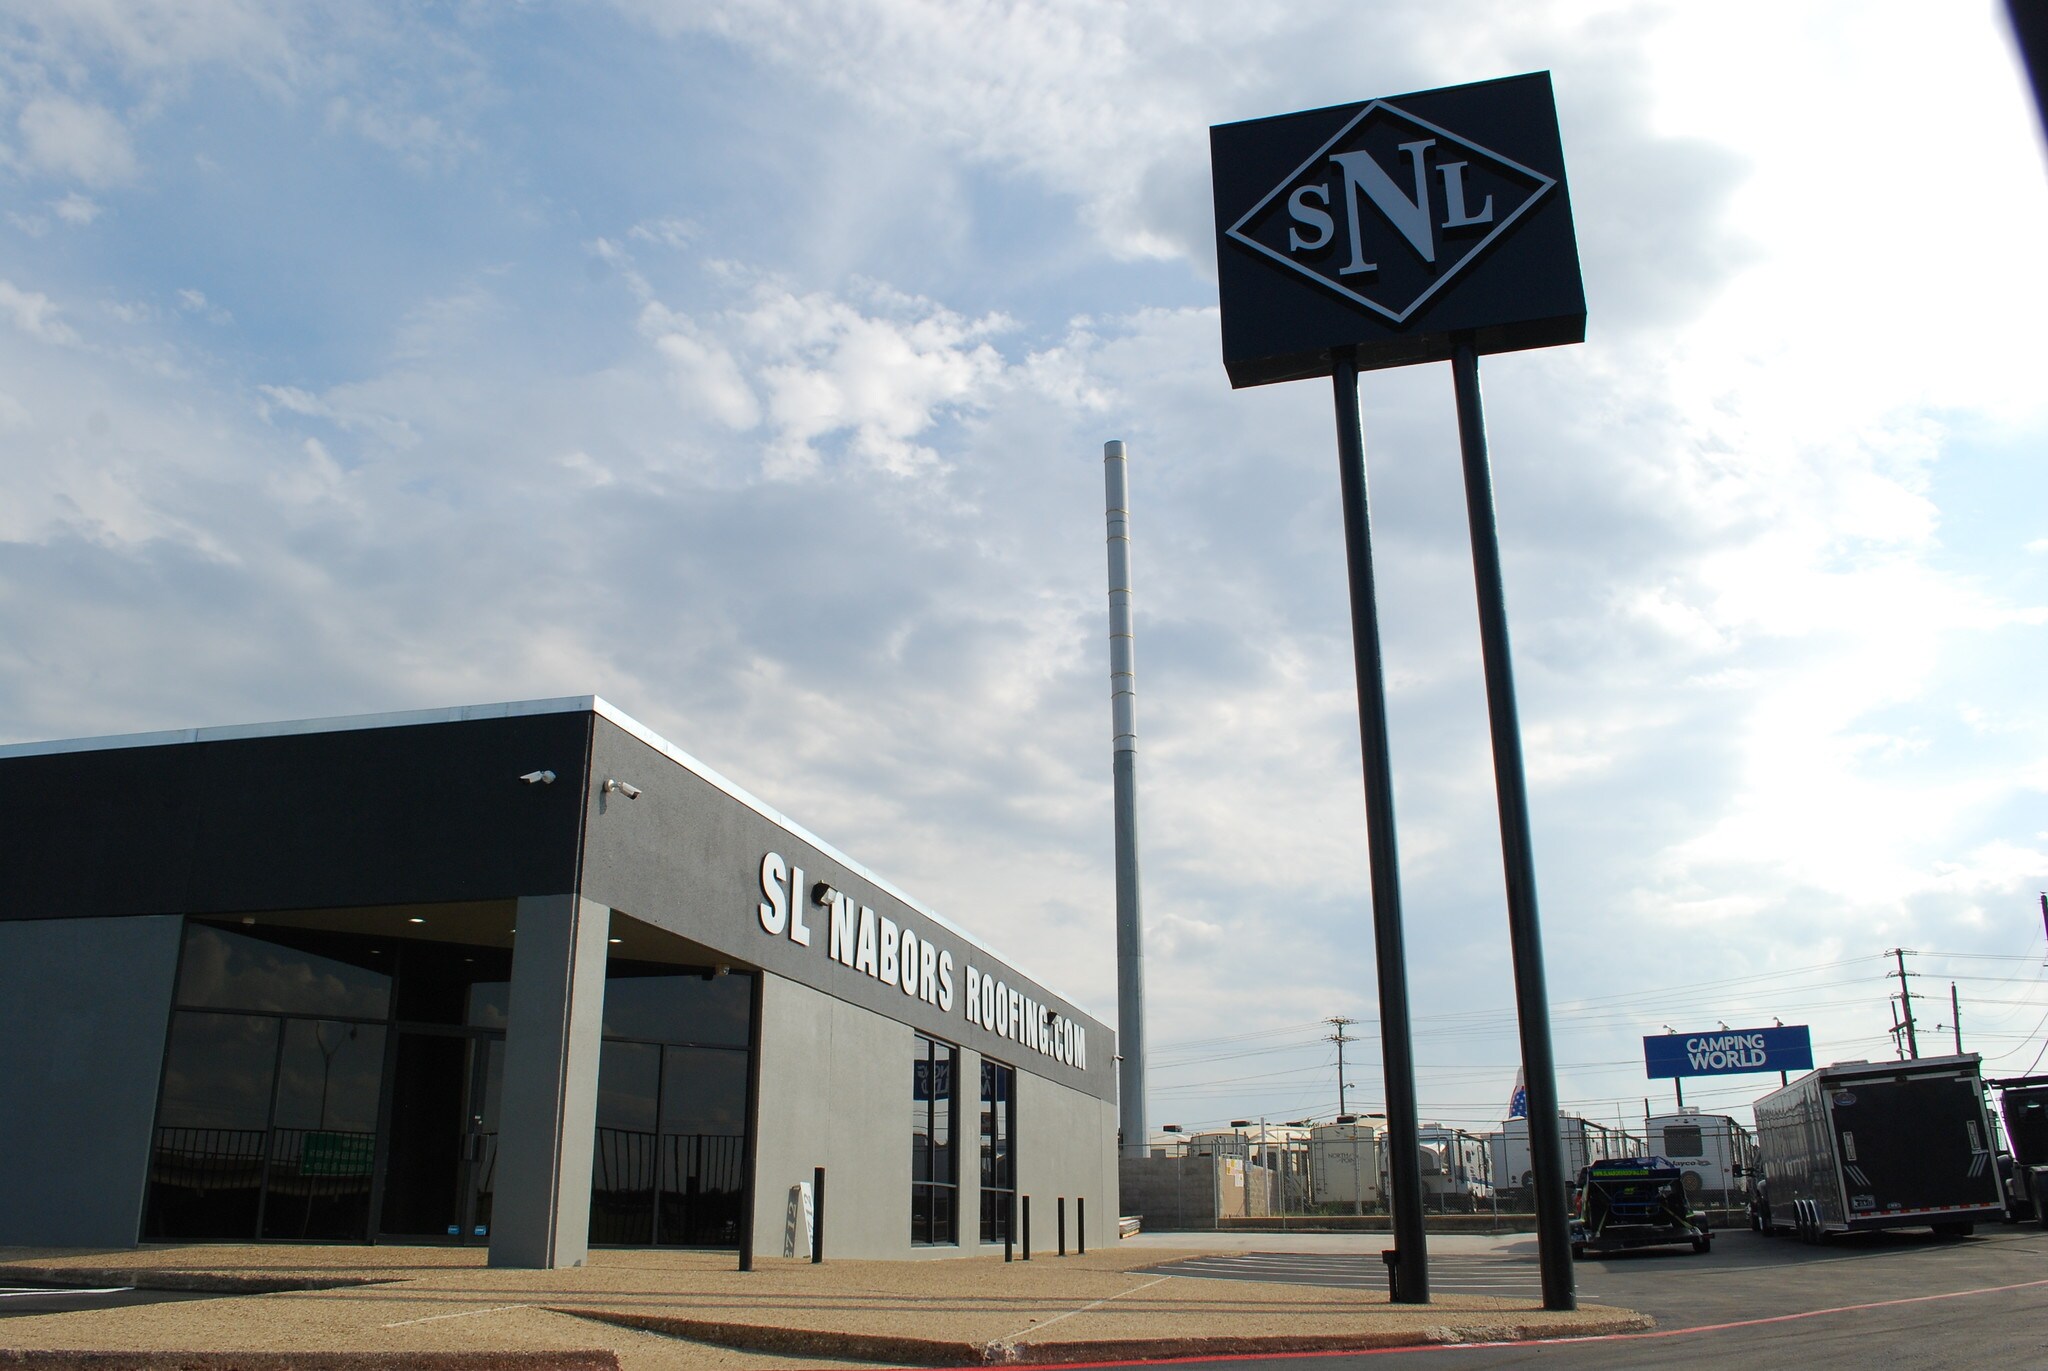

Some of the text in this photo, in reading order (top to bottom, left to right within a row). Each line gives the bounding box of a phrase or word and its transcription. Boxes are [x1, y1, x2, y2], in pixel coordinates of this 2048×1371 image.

[1288, 138, 1493, 275] SNL
[759, 851, 1086, 1070] SL NABORS ROOFING.COM
[1686, 1033, 1765, 1053] CAMPING
[1687, 1048, 1766, 1070] WORLD
